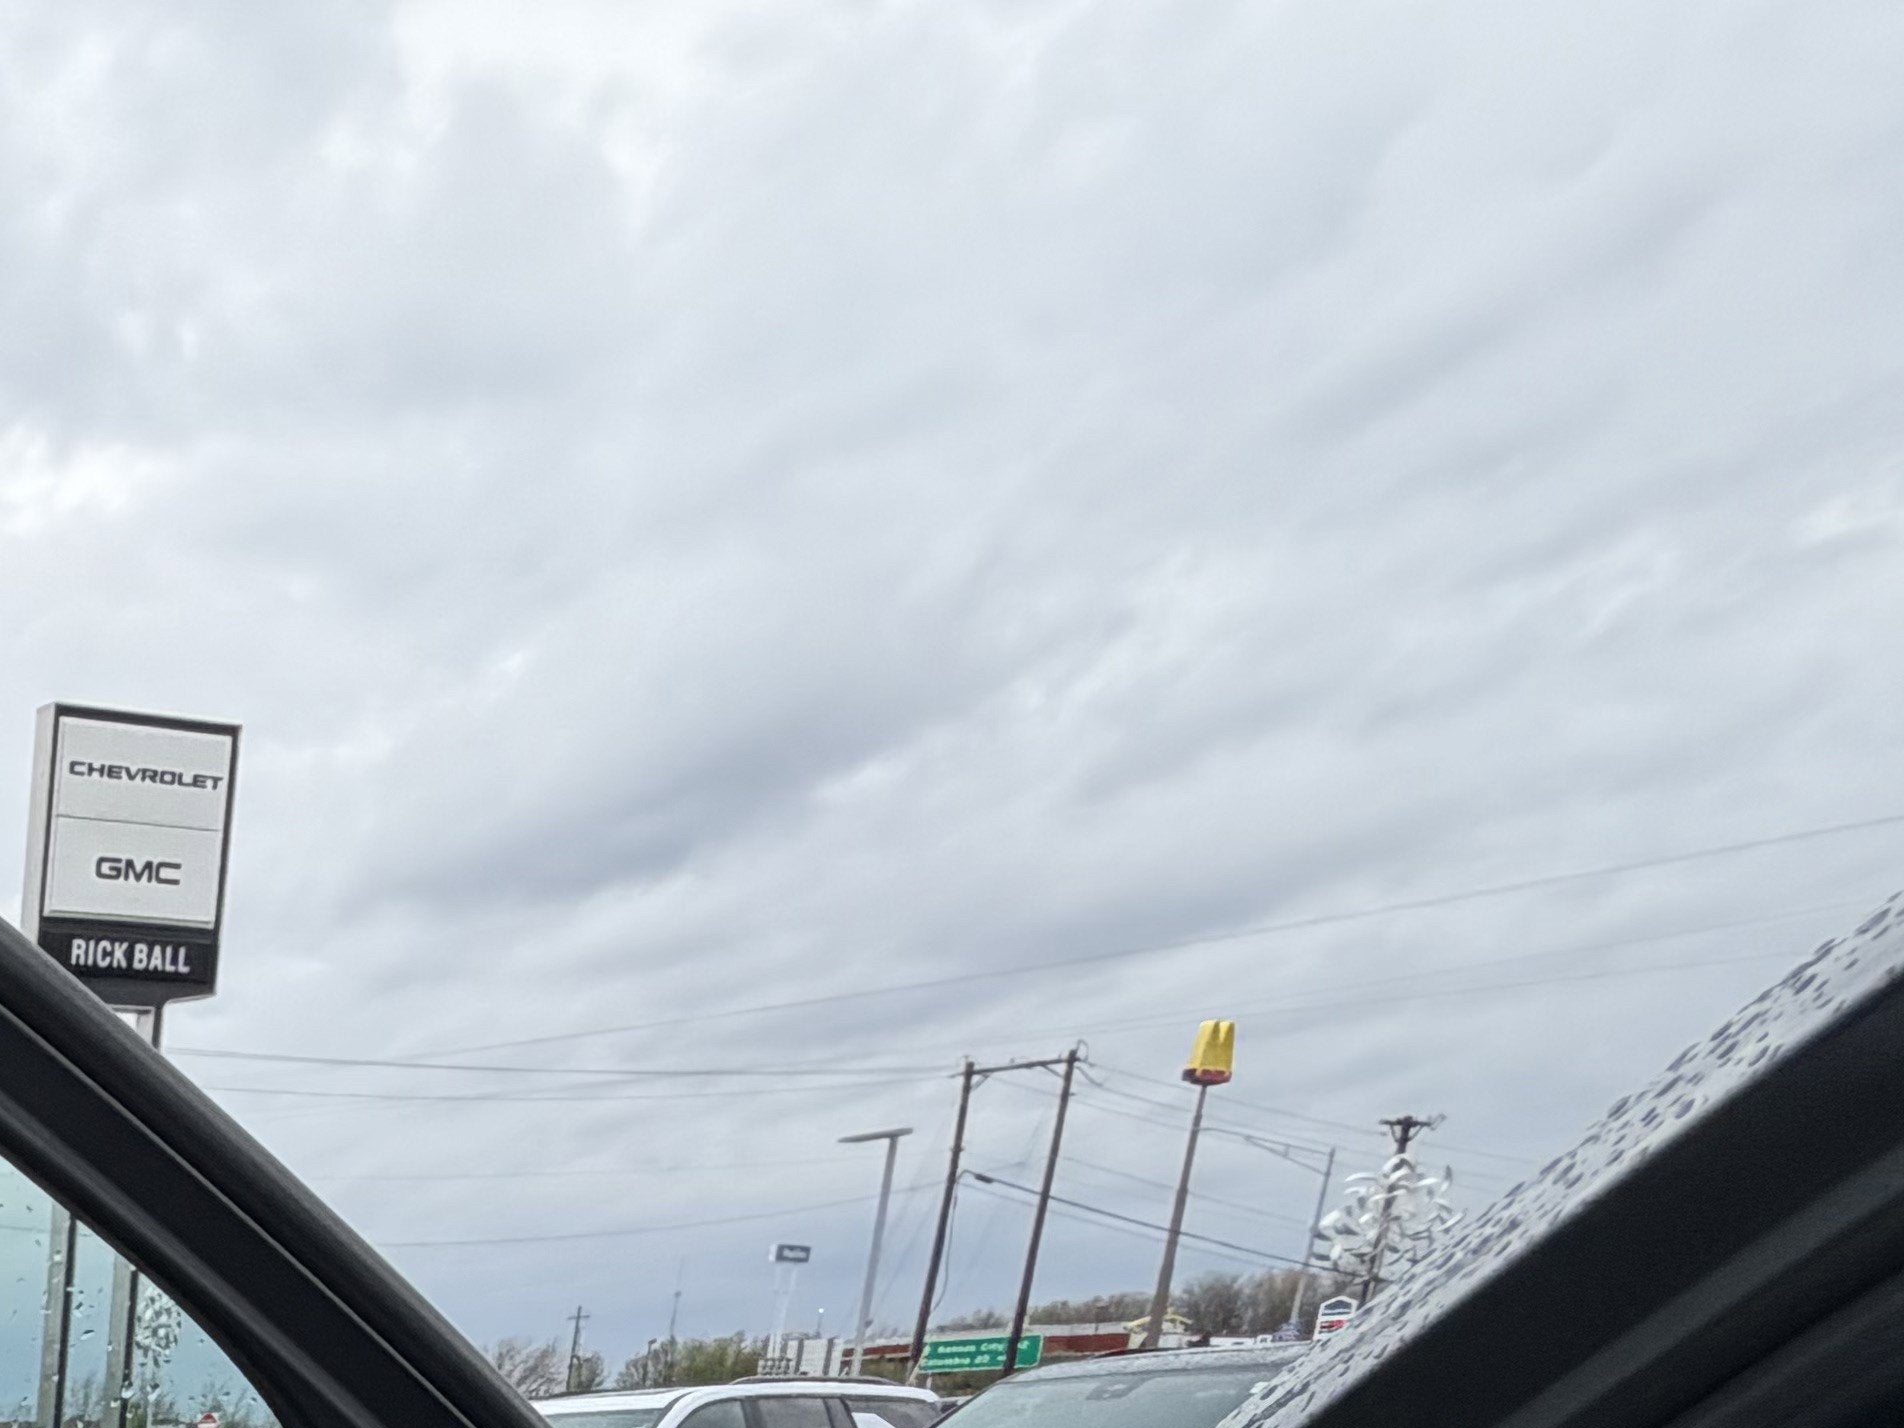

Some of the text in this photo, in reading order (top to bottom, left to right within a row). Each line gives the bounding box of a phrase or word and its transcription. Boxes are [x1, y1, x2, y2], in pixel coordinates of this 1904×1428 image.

[68, 759, 224, 791] CHEVROLET
[94, 856, 182, 886] GMC
[70, 938, 191, 974] RICK BALL
